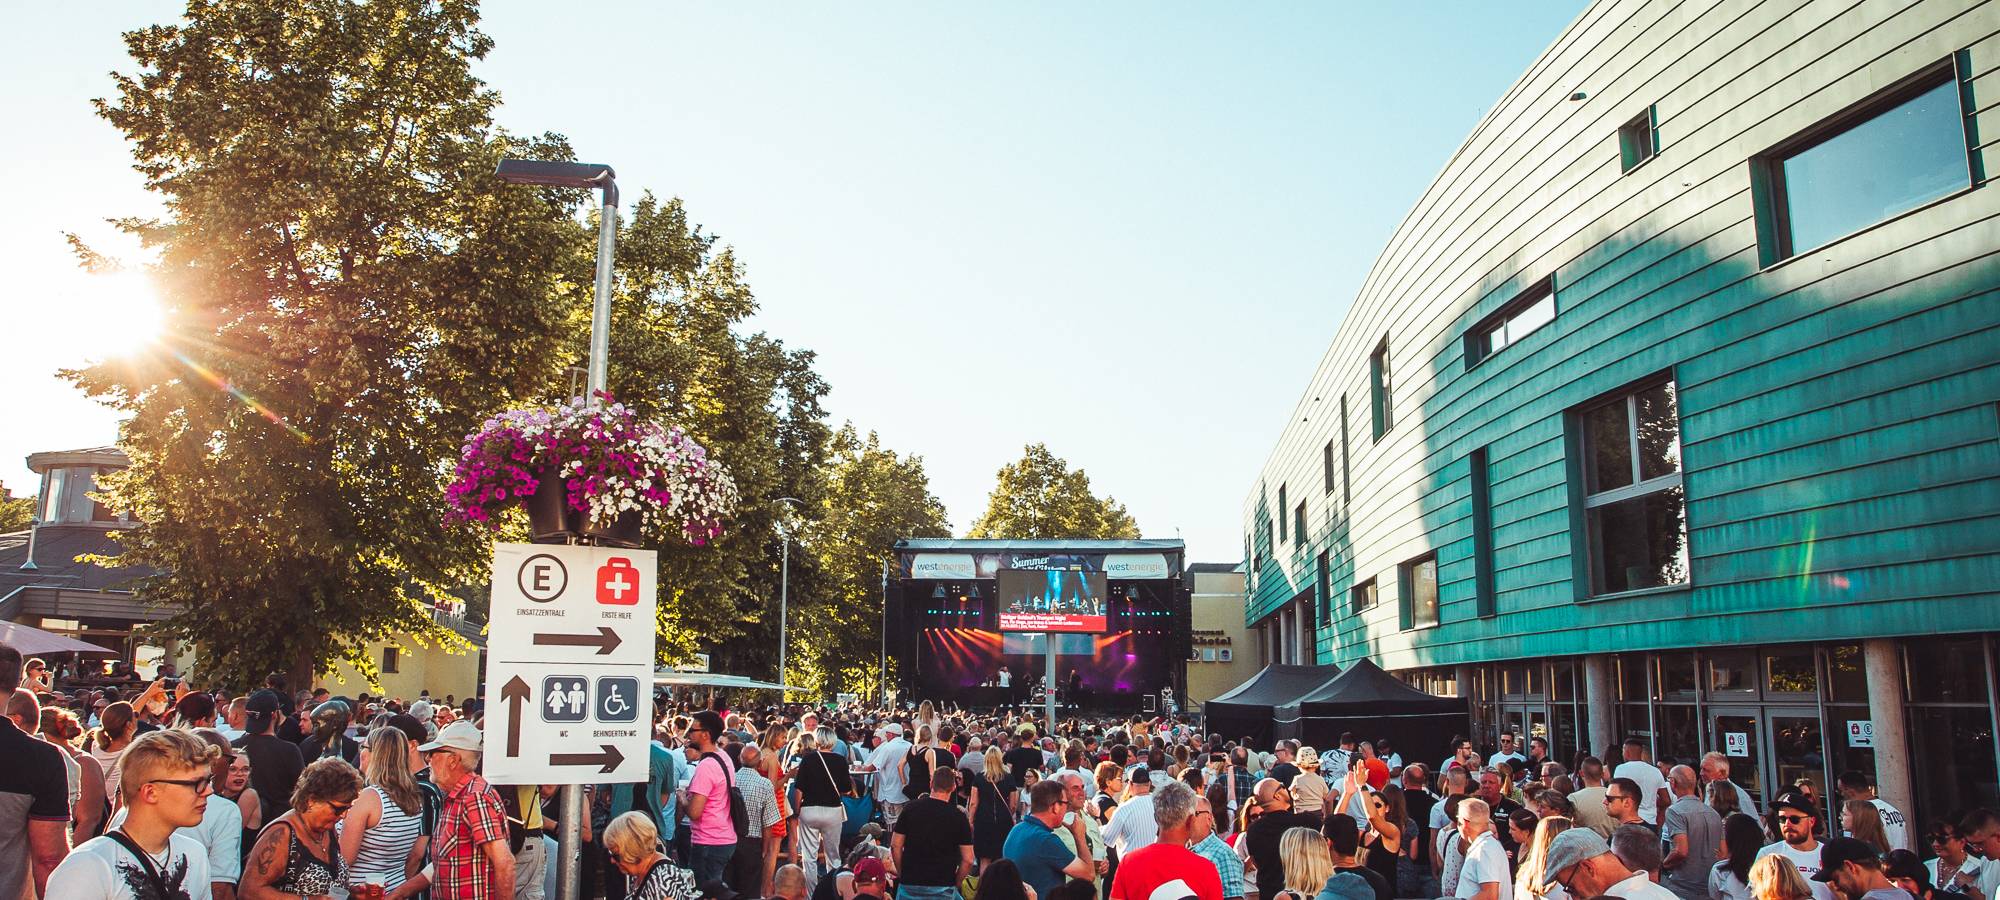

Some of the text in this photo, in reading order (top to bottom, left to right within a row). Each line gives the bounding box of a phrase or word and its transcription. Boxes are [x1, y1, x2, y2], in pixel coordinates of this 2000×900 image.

[1011, 556, 1050, 569] Summer
[1107, 562, 1164, 572] westenergie
[533, 565, 551, 591] E
[516, 608, 566, 617] EINSATZZENTRALE
[601, 611, 632, 620] ERSTE HILFE
[1192, 636, 1232, 646] khotel
